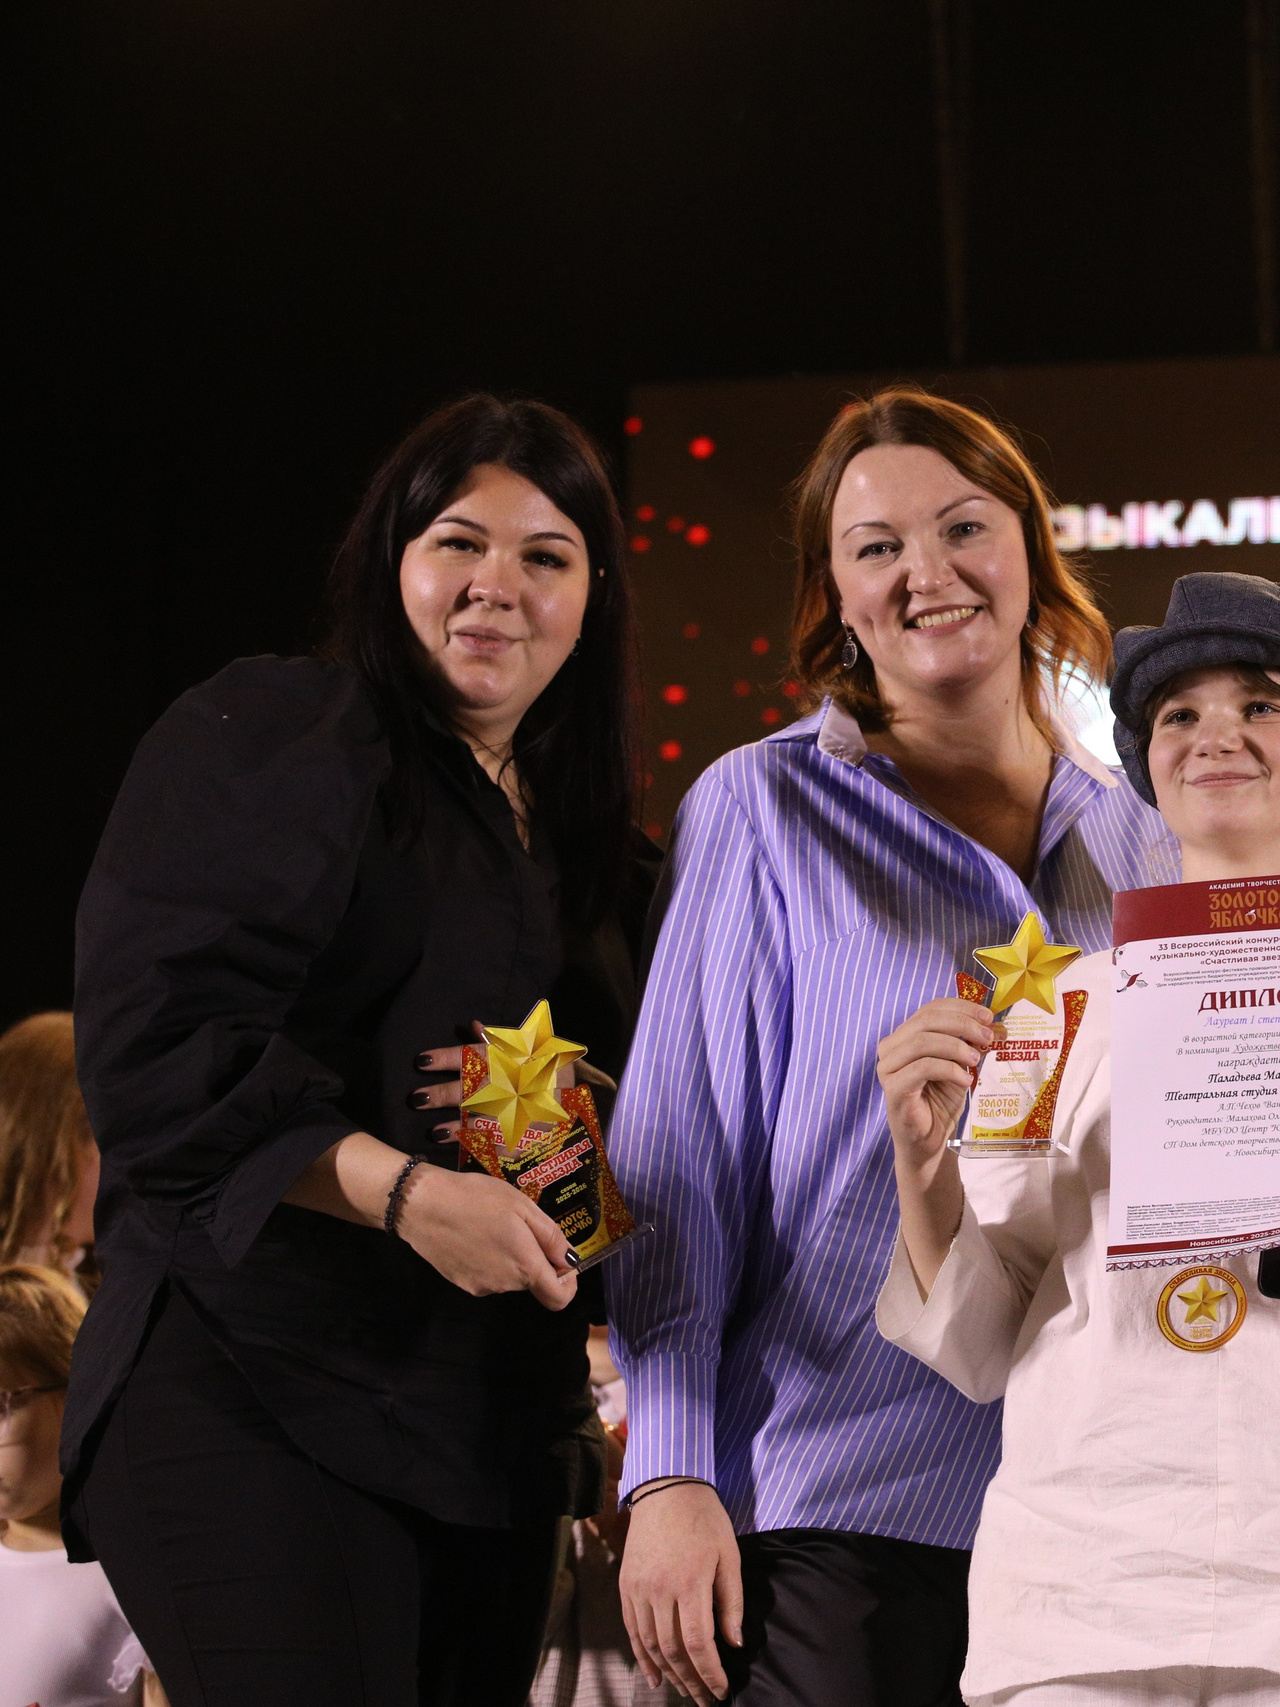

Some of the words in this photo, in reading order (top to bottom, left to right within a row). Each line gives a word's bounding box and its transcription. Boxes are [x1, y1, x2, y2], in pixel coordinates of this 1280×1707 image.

[1209, 882, 1245, 890] АКАДЕМИЯ
[1158, 943, 1168, 951] 33
[1171, 937, 1243, 949] Всероссийский
[1200, 956, 1259, 965] «Счастливая
[1204, 1016, 1247, 1028] Лауреат
[1183, 1035, 1189, 1043] В
[1191, 1032, 1237, 1044] возрастной
[1238, 1031, 1280, 1041] категории
[1184, 1046, 1230, 1054] номинации
[995, 1051, 1040, 1062] ЗВЕЗДА
[1207, 1070, 1261, 1083] Паладьева
[1164, 1090, 1238, 1103] Театральная
[1240, 1085, 1278, 1099] студия
[978, 1098, 1020, 1108] ЗОЛОТОЕ
[977, 1107, 1019, 1118] ЯБЛОЧКО
[1165, 1115, 1224, 1128] Руководитель:
[1226, 1114, 1266, 1122] Малахова
[1201, 1126, 1239, 1136] МБУДО
[1240, 1125, 1268, 1135] Центр
[1163, 1141, 1178, 1149] СП
[1179, 1140, 1197, 1148] Дом
[1199, 1139, 1235, 1147] детского
[517, 1139, 592, 1186] СЧАСТЛИВАЯ
[539, 1159, 582, 1187] ЗВЕЗДА
[555, 1183, 587, 1204] 2025-2026
[560, 1182, 577, 1194] сезон
[1190, 1236, 1244, 1247] Новосибирск
[1169, 1267, 1213, 1289] СЧАСТЛИВАЯ
[1213, 1268, 1237, 1286] ЗВЕЗДА
